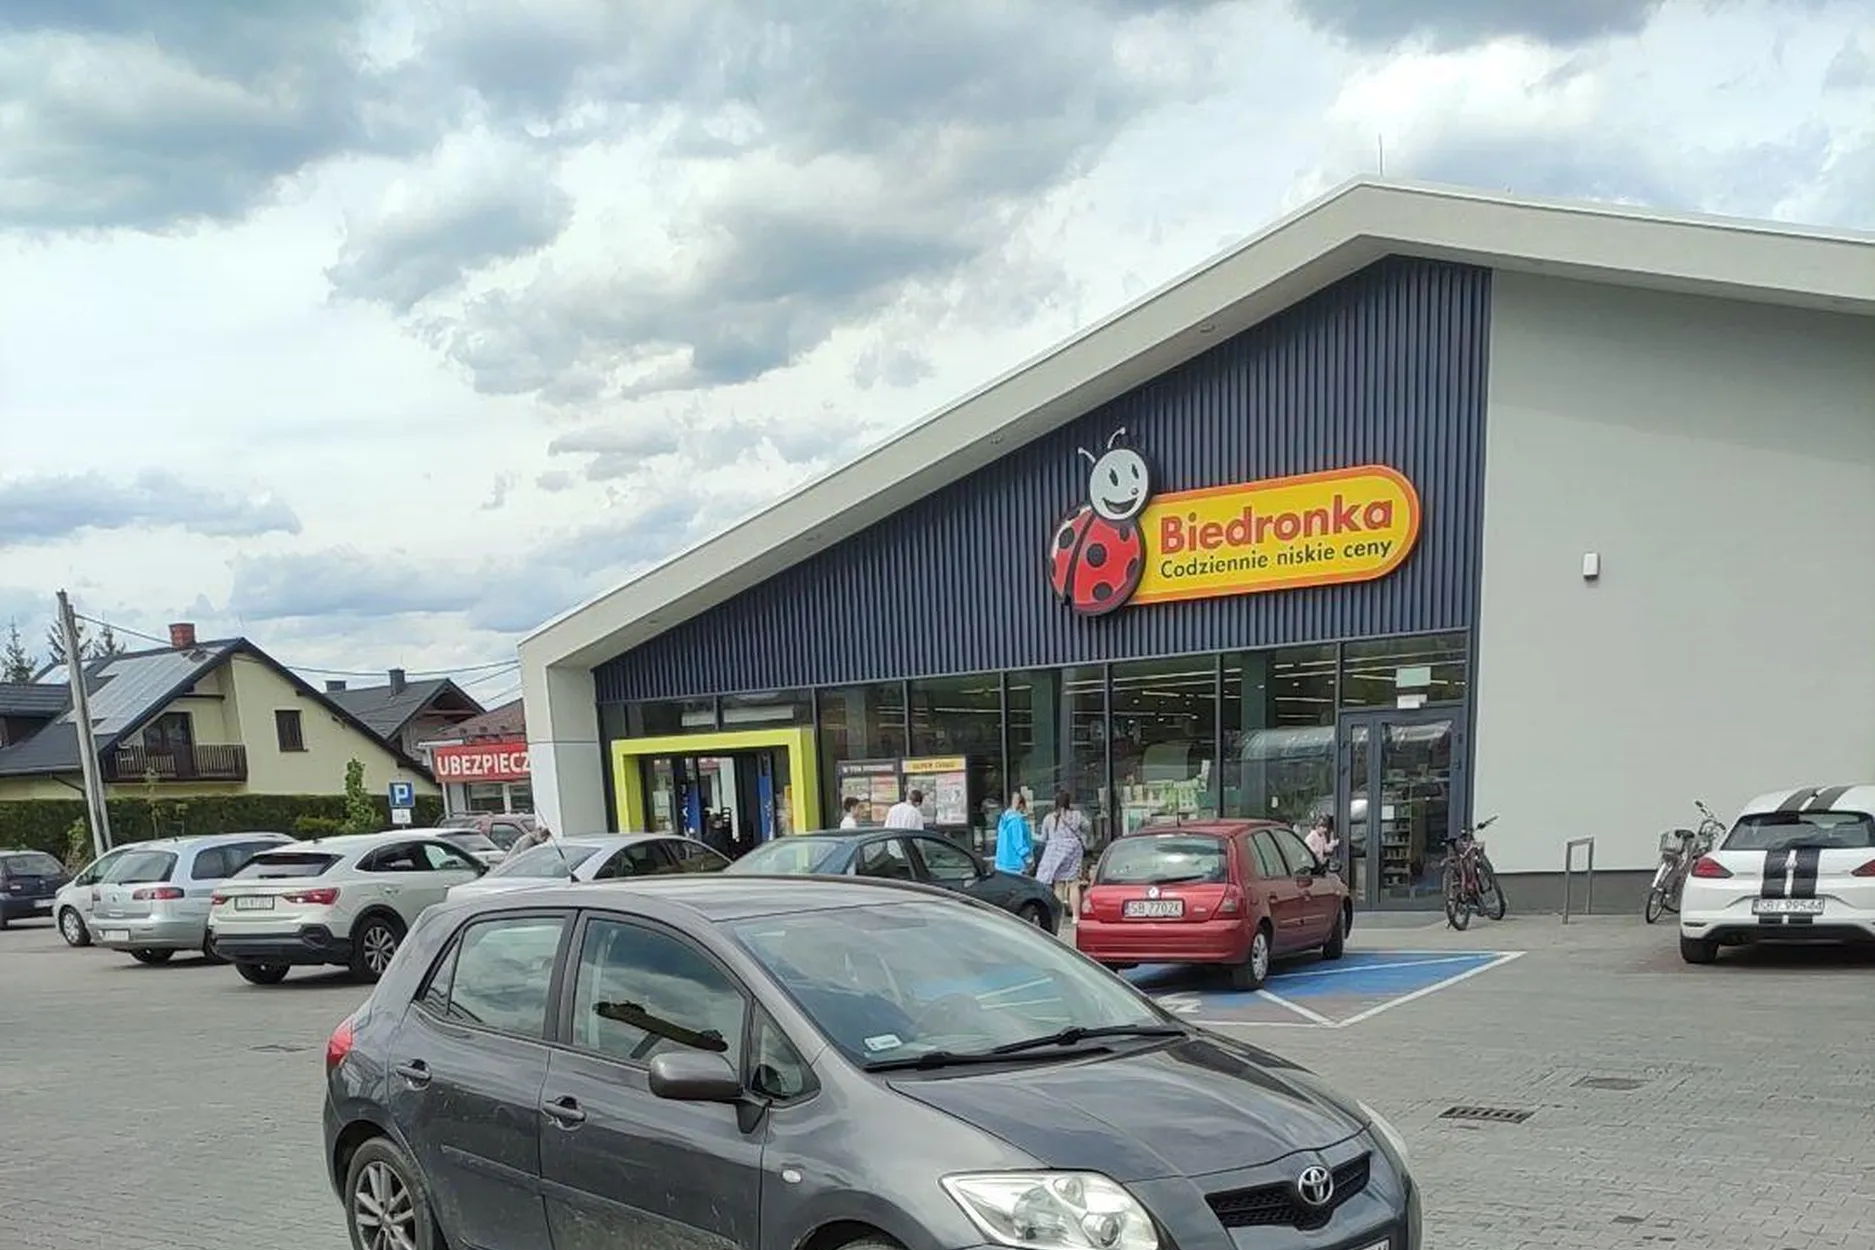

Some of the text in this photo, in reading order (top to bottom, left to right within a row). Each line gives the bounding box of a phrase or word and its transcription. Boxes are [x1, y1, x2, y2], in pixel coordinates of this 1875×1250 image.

[1160, 494, 1394, 555] Biedronka
[1160, 540, 1393, 579] Codziennie niskie ceny
[394, 784, 408, 804] P
